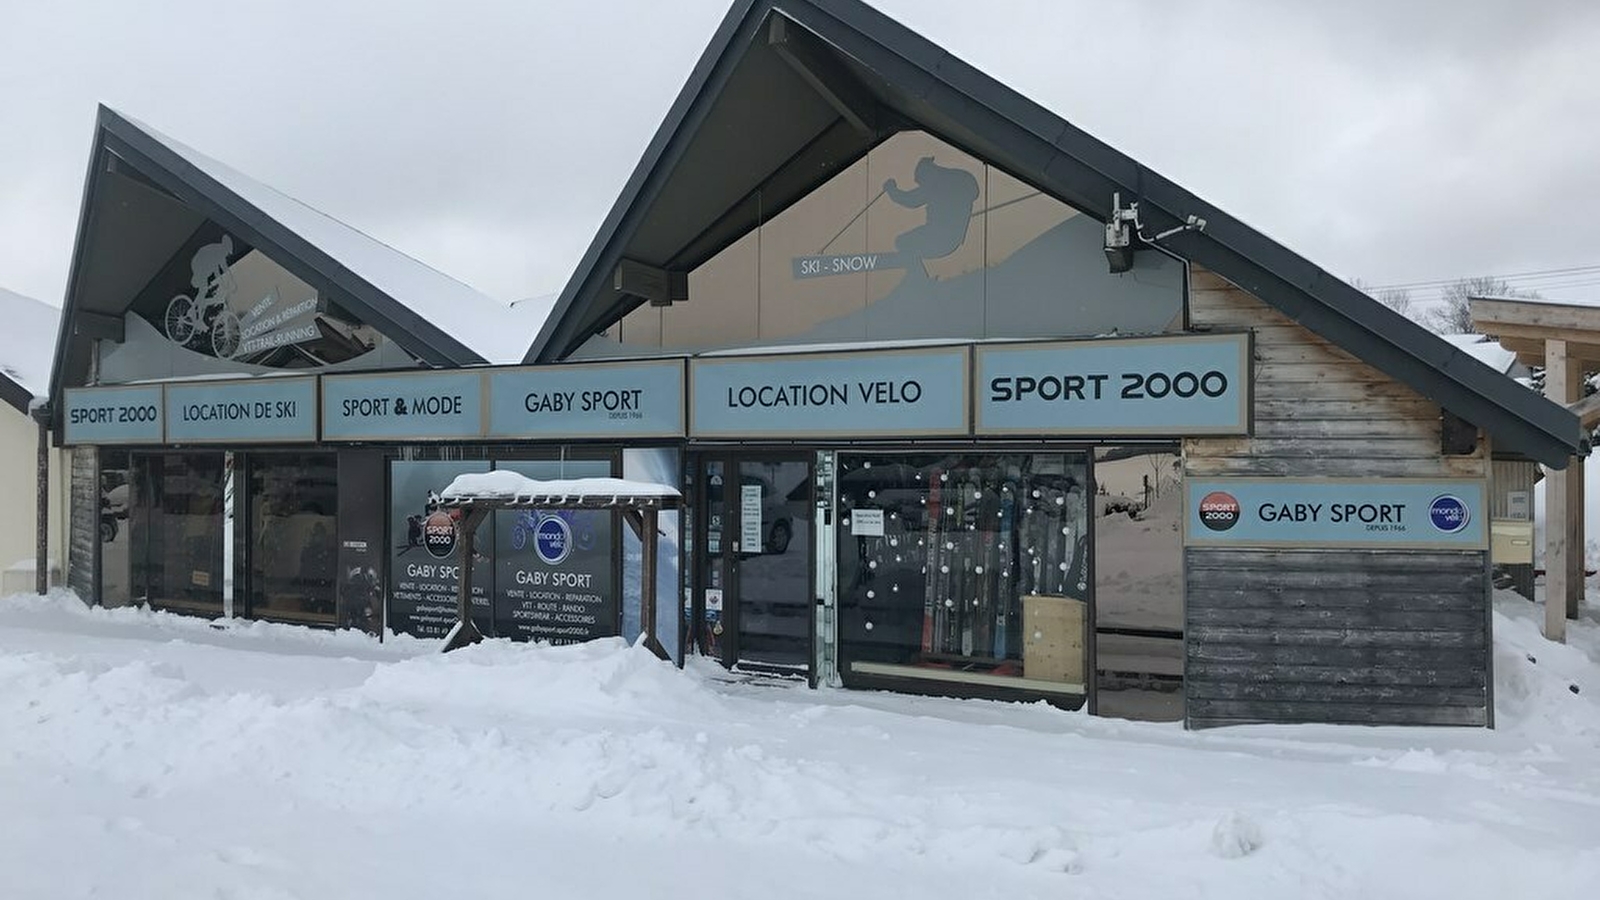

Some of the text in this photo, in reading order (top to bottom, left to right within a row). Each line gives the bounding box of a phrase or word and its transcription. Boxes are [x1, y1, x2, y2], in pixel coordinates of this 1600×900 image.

[801, 260, 820, 274] SKI
[832, 255, 878, 272] SNOW
[250, 296, 273, 317] VENTE
[240, 316, 276, 340] LOCATION
[728, 380, 922, 408] LOCATION VELO
[991, 370, 1228, 402] SPORT 2000
[342, 395, 462, 417] SPORT & MODE
[525, 389, 642, 413] GABY SPORT
[71, 405, 157, 424] SPORT 2000
[183, 401, 297, 422] LOCATION DE SKI
[1202, 503, 1236, 512] SPORT
[1205, 511, 1234, 520] 2000
[1258, 503, 1406, 523] GABY SPORT
[1432, 506, 1464, 516] mondo
[427, 526, 454, 535] SPORT
[1366, 524, 1406, 532] DEPUIS 1966
[429, 536, 451, 545] 2000
[407, 563, 460, 579] GABY SPO
[516, 570, 592, 588] GABY SPORT
[400, 582, 415, 590] VENTE
[420, 583, 448, 592] LOCATION
[506, 589, 525, 599] VENTE
[529, 590, 560, 600] LOCATION
[565, 592, 602, 603] REPARATION
[521, 601, 532, 609] VTT
[537, 602, 557, 611] ROUTE
[562, 604, 585, 613] RANDO
[512, 610, 550, 620] SPORTSWEAR
[554, 613, 596, 624] ACCESSOIRES
